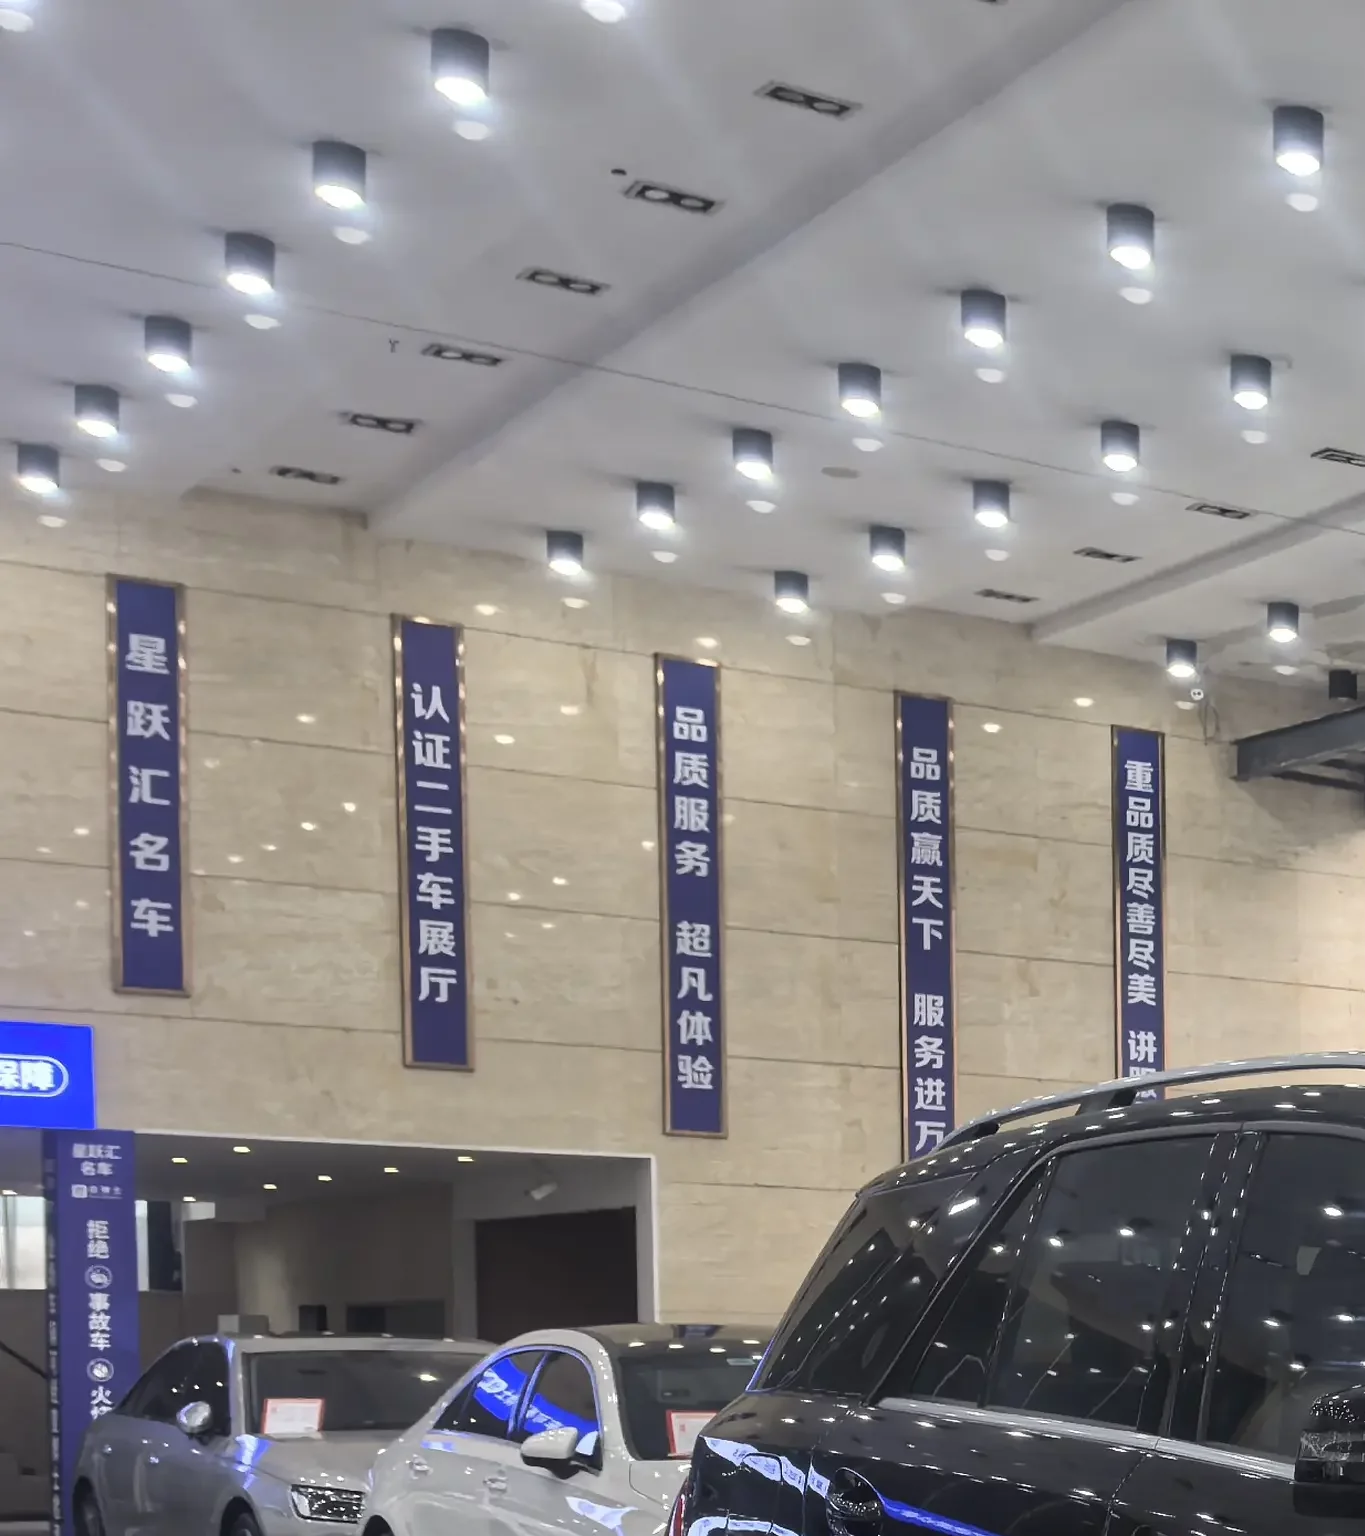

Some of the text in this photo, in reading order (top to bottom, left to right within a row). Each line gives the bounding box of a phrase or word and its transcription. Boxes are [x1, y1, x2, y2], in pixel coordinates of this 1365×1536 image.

[126, 633, 175, 938] 星跃汇名车
[410, 682, 457, 1004] 认证二手车展厅
[672, 706, 715, 1091] 品质服务 超凡体验
[909, 746, 944, 951] 品质赢天下
[1123, 759, 1156, 1007] 重品质尽善尽美
